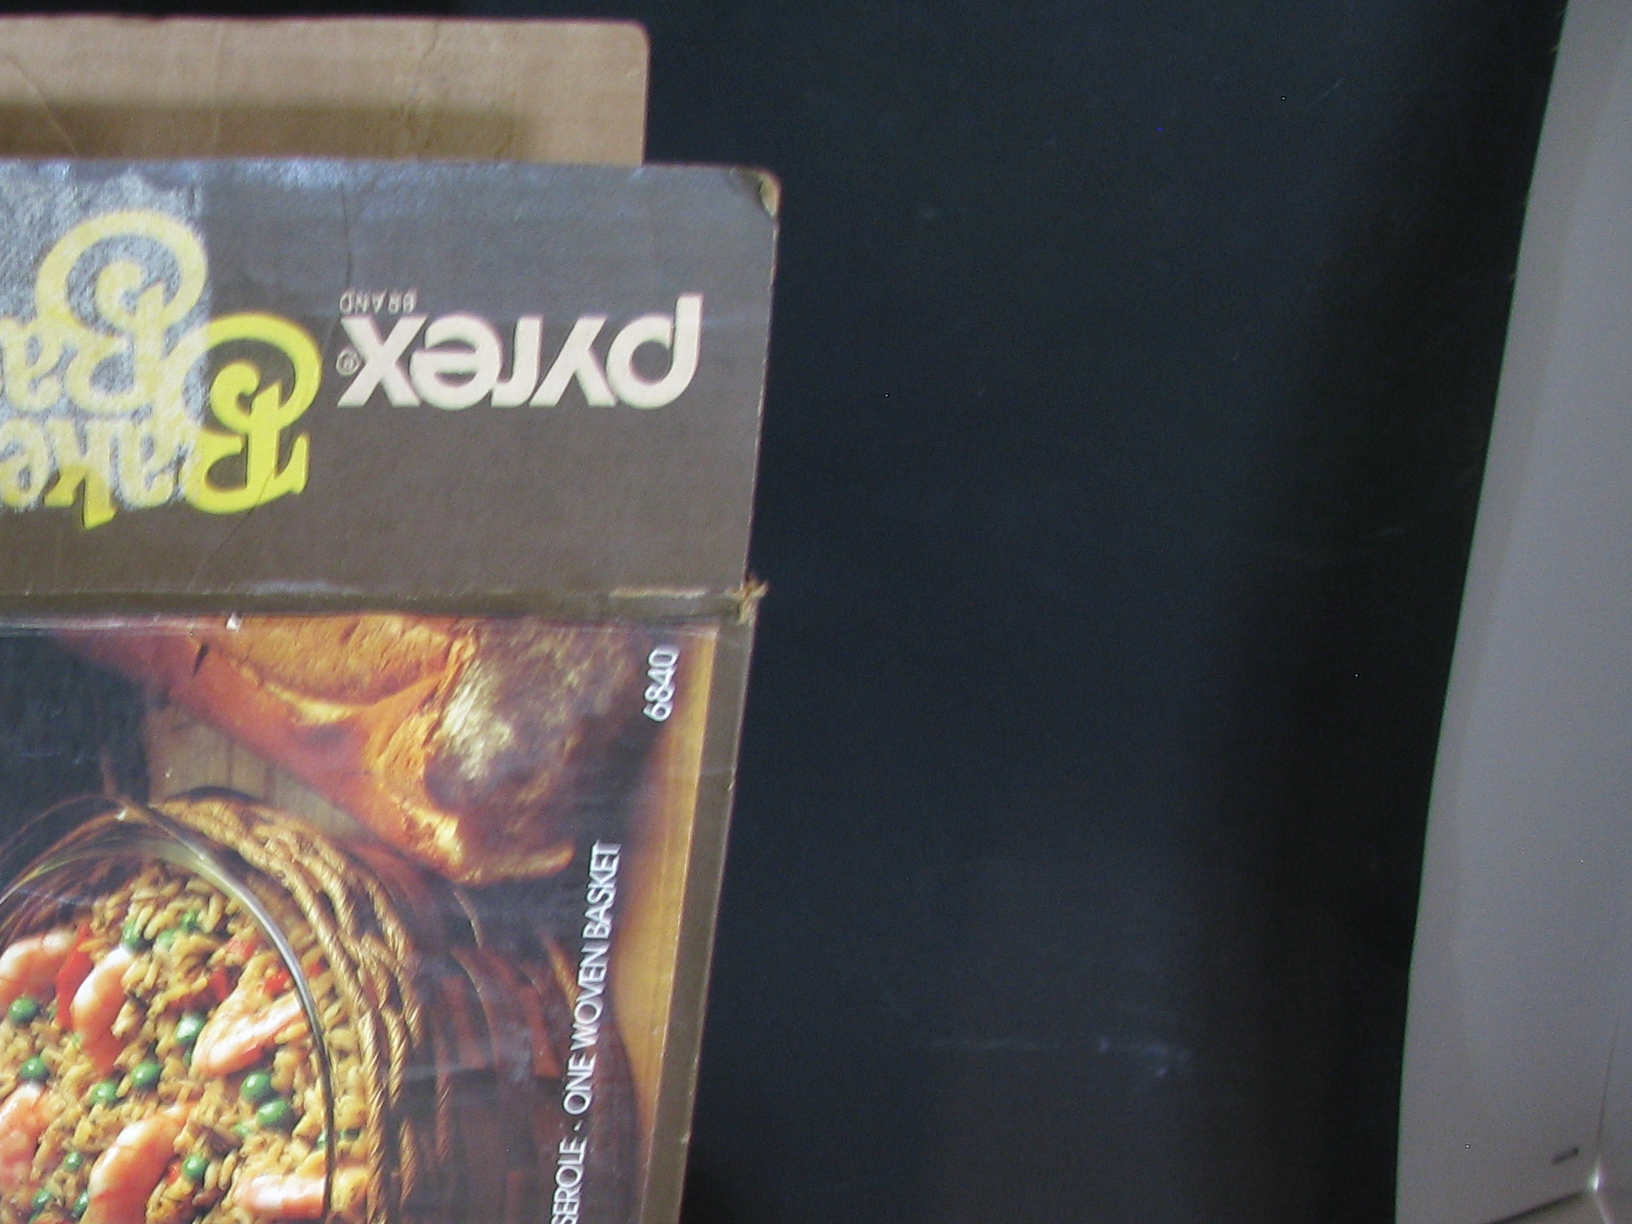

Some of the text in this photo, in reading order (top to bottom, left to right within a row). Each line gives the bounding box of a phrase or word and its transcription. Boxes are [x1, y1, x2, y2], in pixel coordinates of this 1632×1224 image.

[339, 288, 418, 314] BRAND
[336, 294, 704, 411] pyrex
[642, 648, 679, 722] 6840
[582, 839, 623, 940] BASKET
[570, 940, 610, 1051] WOVEN
[563, 1053, 596, 1116] ONE
